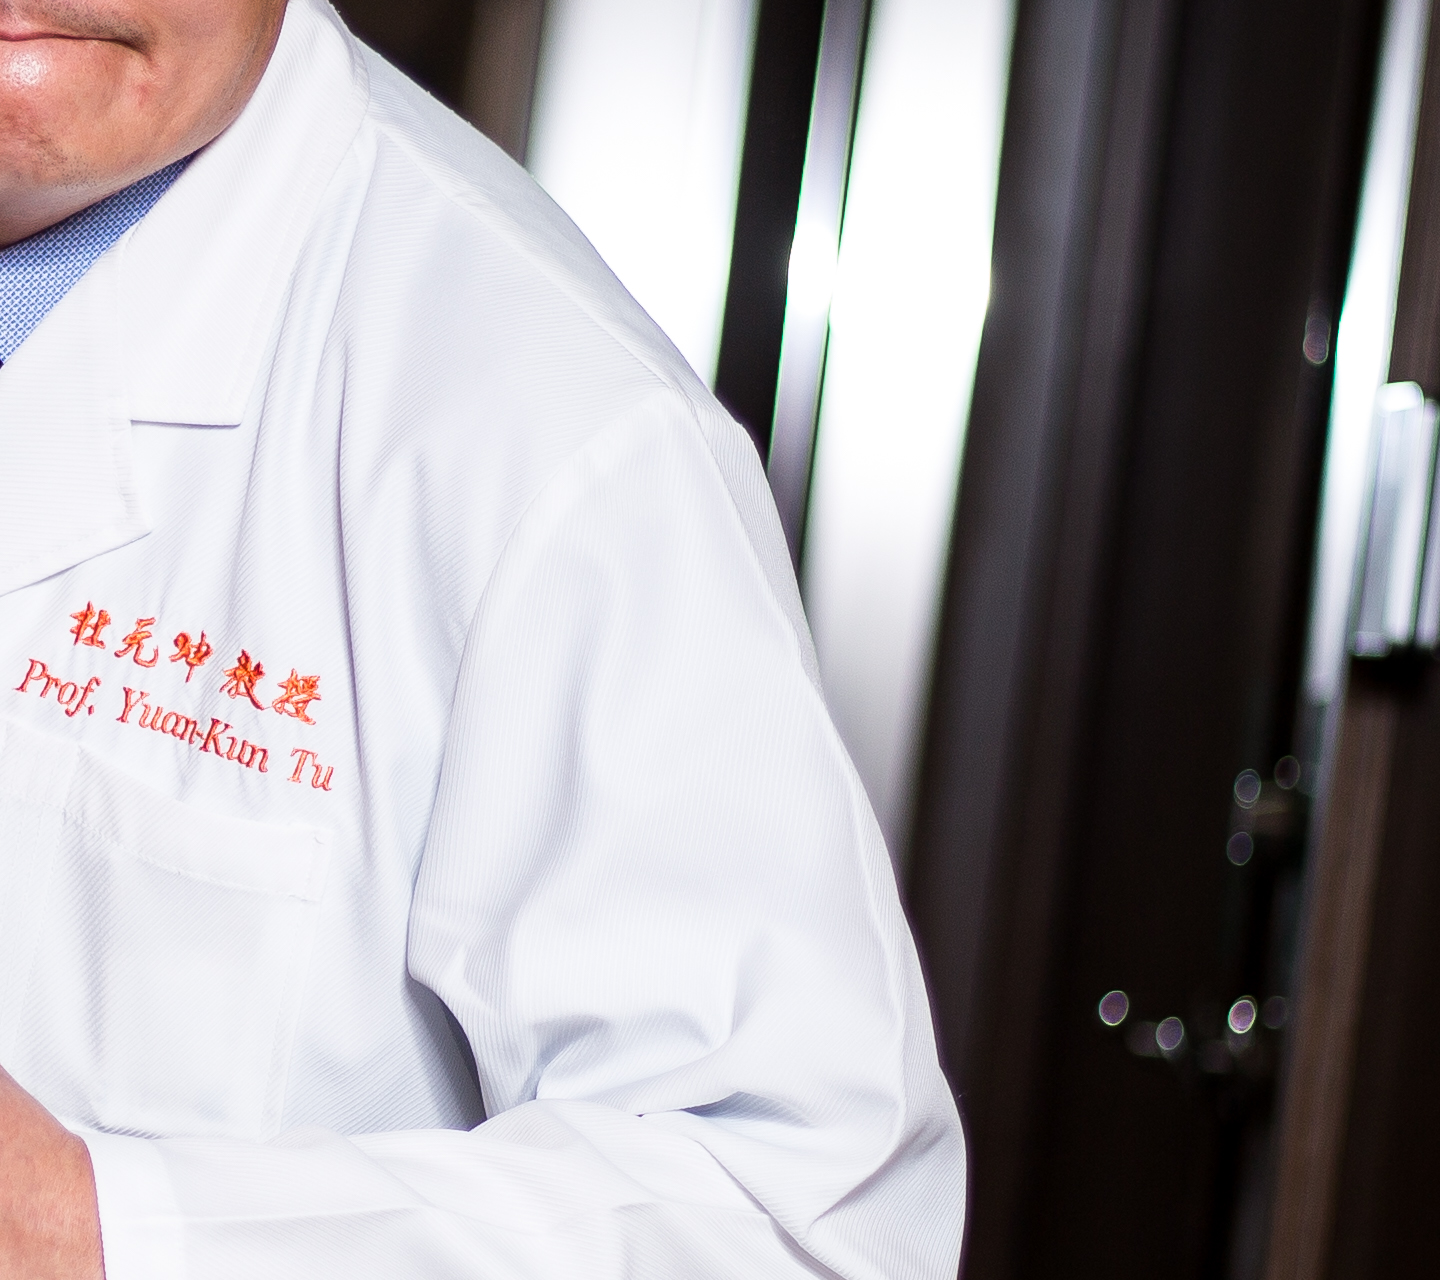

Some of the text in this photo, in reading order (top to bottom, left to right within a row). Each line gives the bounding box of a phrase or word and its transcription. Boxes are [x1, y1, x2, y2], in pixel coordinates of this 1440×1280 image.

[15, 658, 334, 792] Prof. Yuan-Kun Tu
